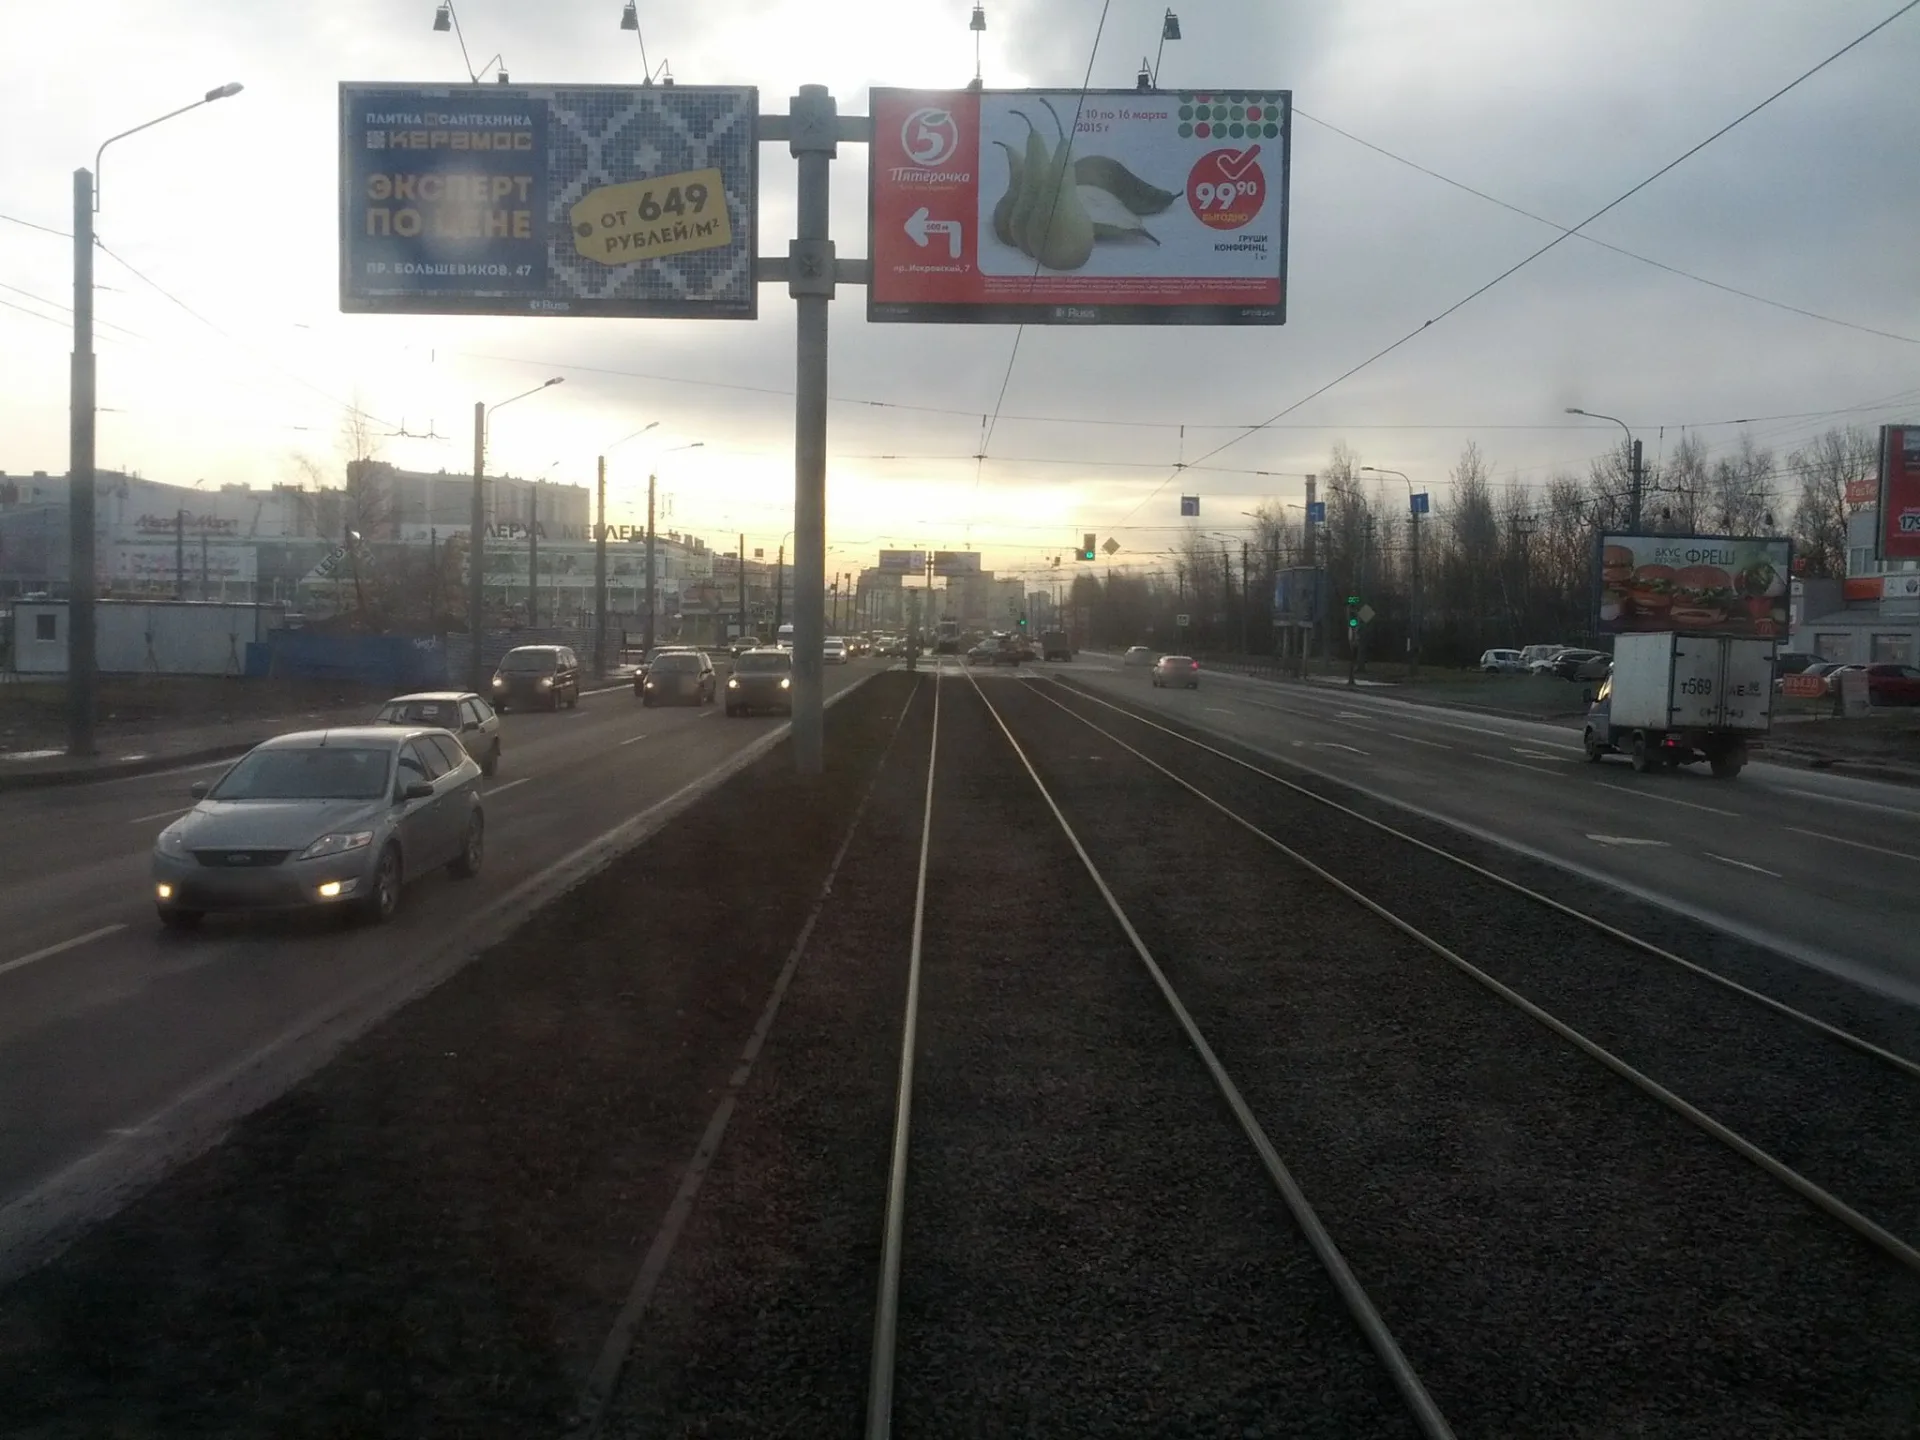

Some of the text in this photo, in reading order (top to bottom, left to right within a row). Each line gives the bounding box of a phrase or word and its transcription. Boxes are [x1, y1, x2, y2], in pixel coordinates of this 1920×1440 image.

[366, 112, 424, 125] ПЛИТКА
[438, 113, 532, 126] САНТЕХНИКА
[1086, 109, 1098, 119] 10
[1100, 111, 1115, 119] по
[1119, 109, 1130, 119] 16
[1132, 111, 1168, 122] марта
[1077, 122, 1102, 132] 2015
[366, 173, 533, 202] ЭКСПЕРТ
[600, 182, 709, 230] ОТ 649
[366, 207, 422, 237] ПО
[1238, 234, 1268, 243] ГРУШИ
[366, 262, 391, 274] ПР.
[516, 265, 532, 276] 47
[1655, 547, 1736, 565] ВКУС ФРЕШ
